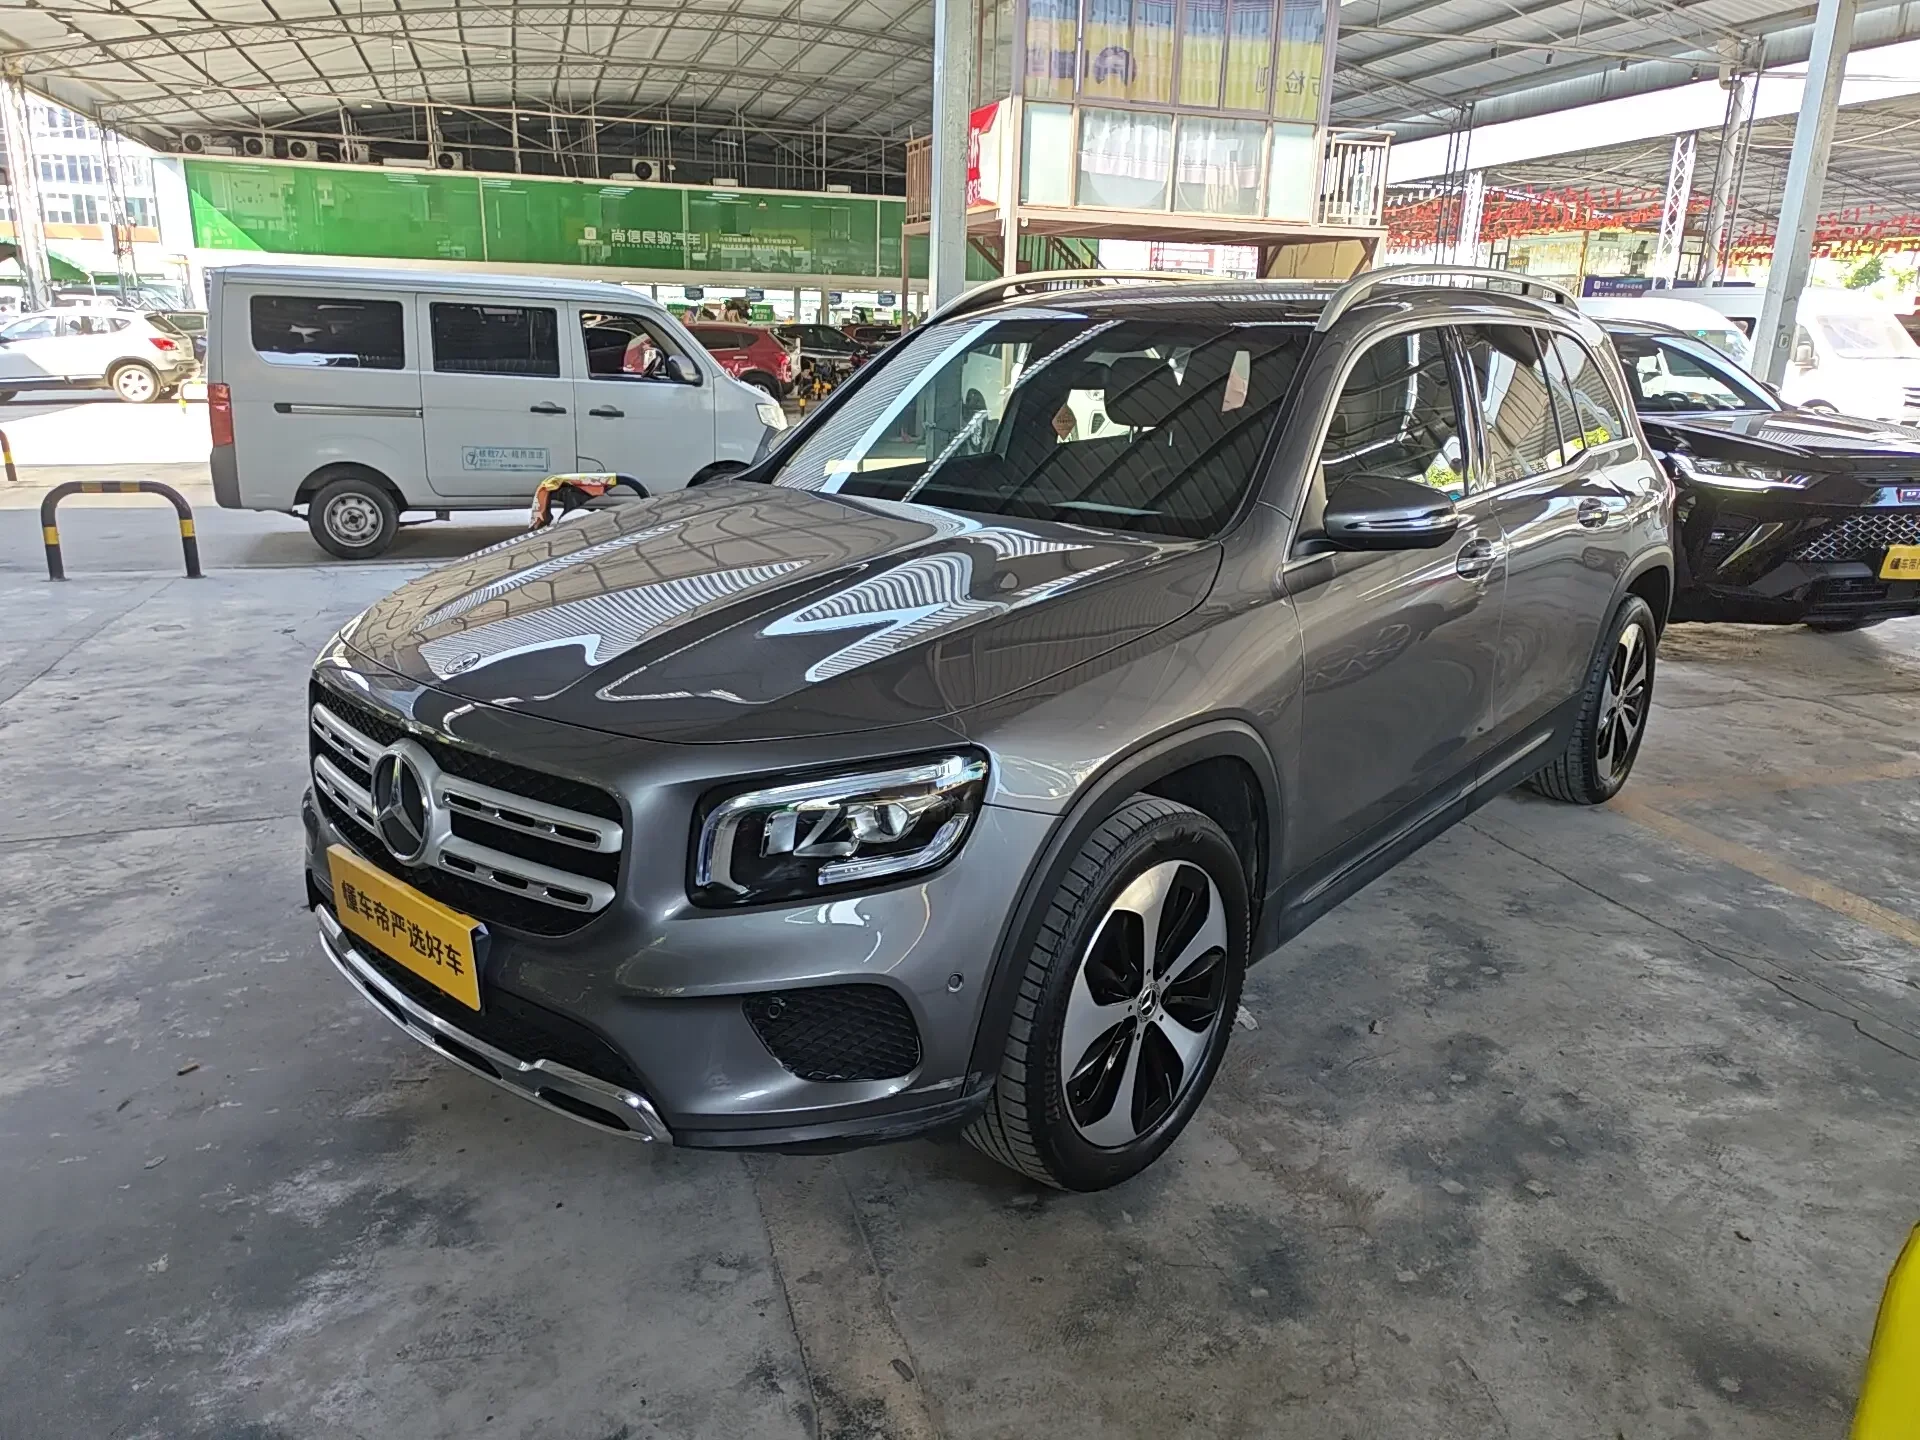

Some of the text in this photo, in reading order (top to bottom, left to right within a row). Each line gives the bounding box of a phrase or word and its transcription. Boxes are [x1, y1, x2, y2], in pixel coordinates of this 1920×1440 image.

[341, 879, 465, 976] 懂车帝严选好车
